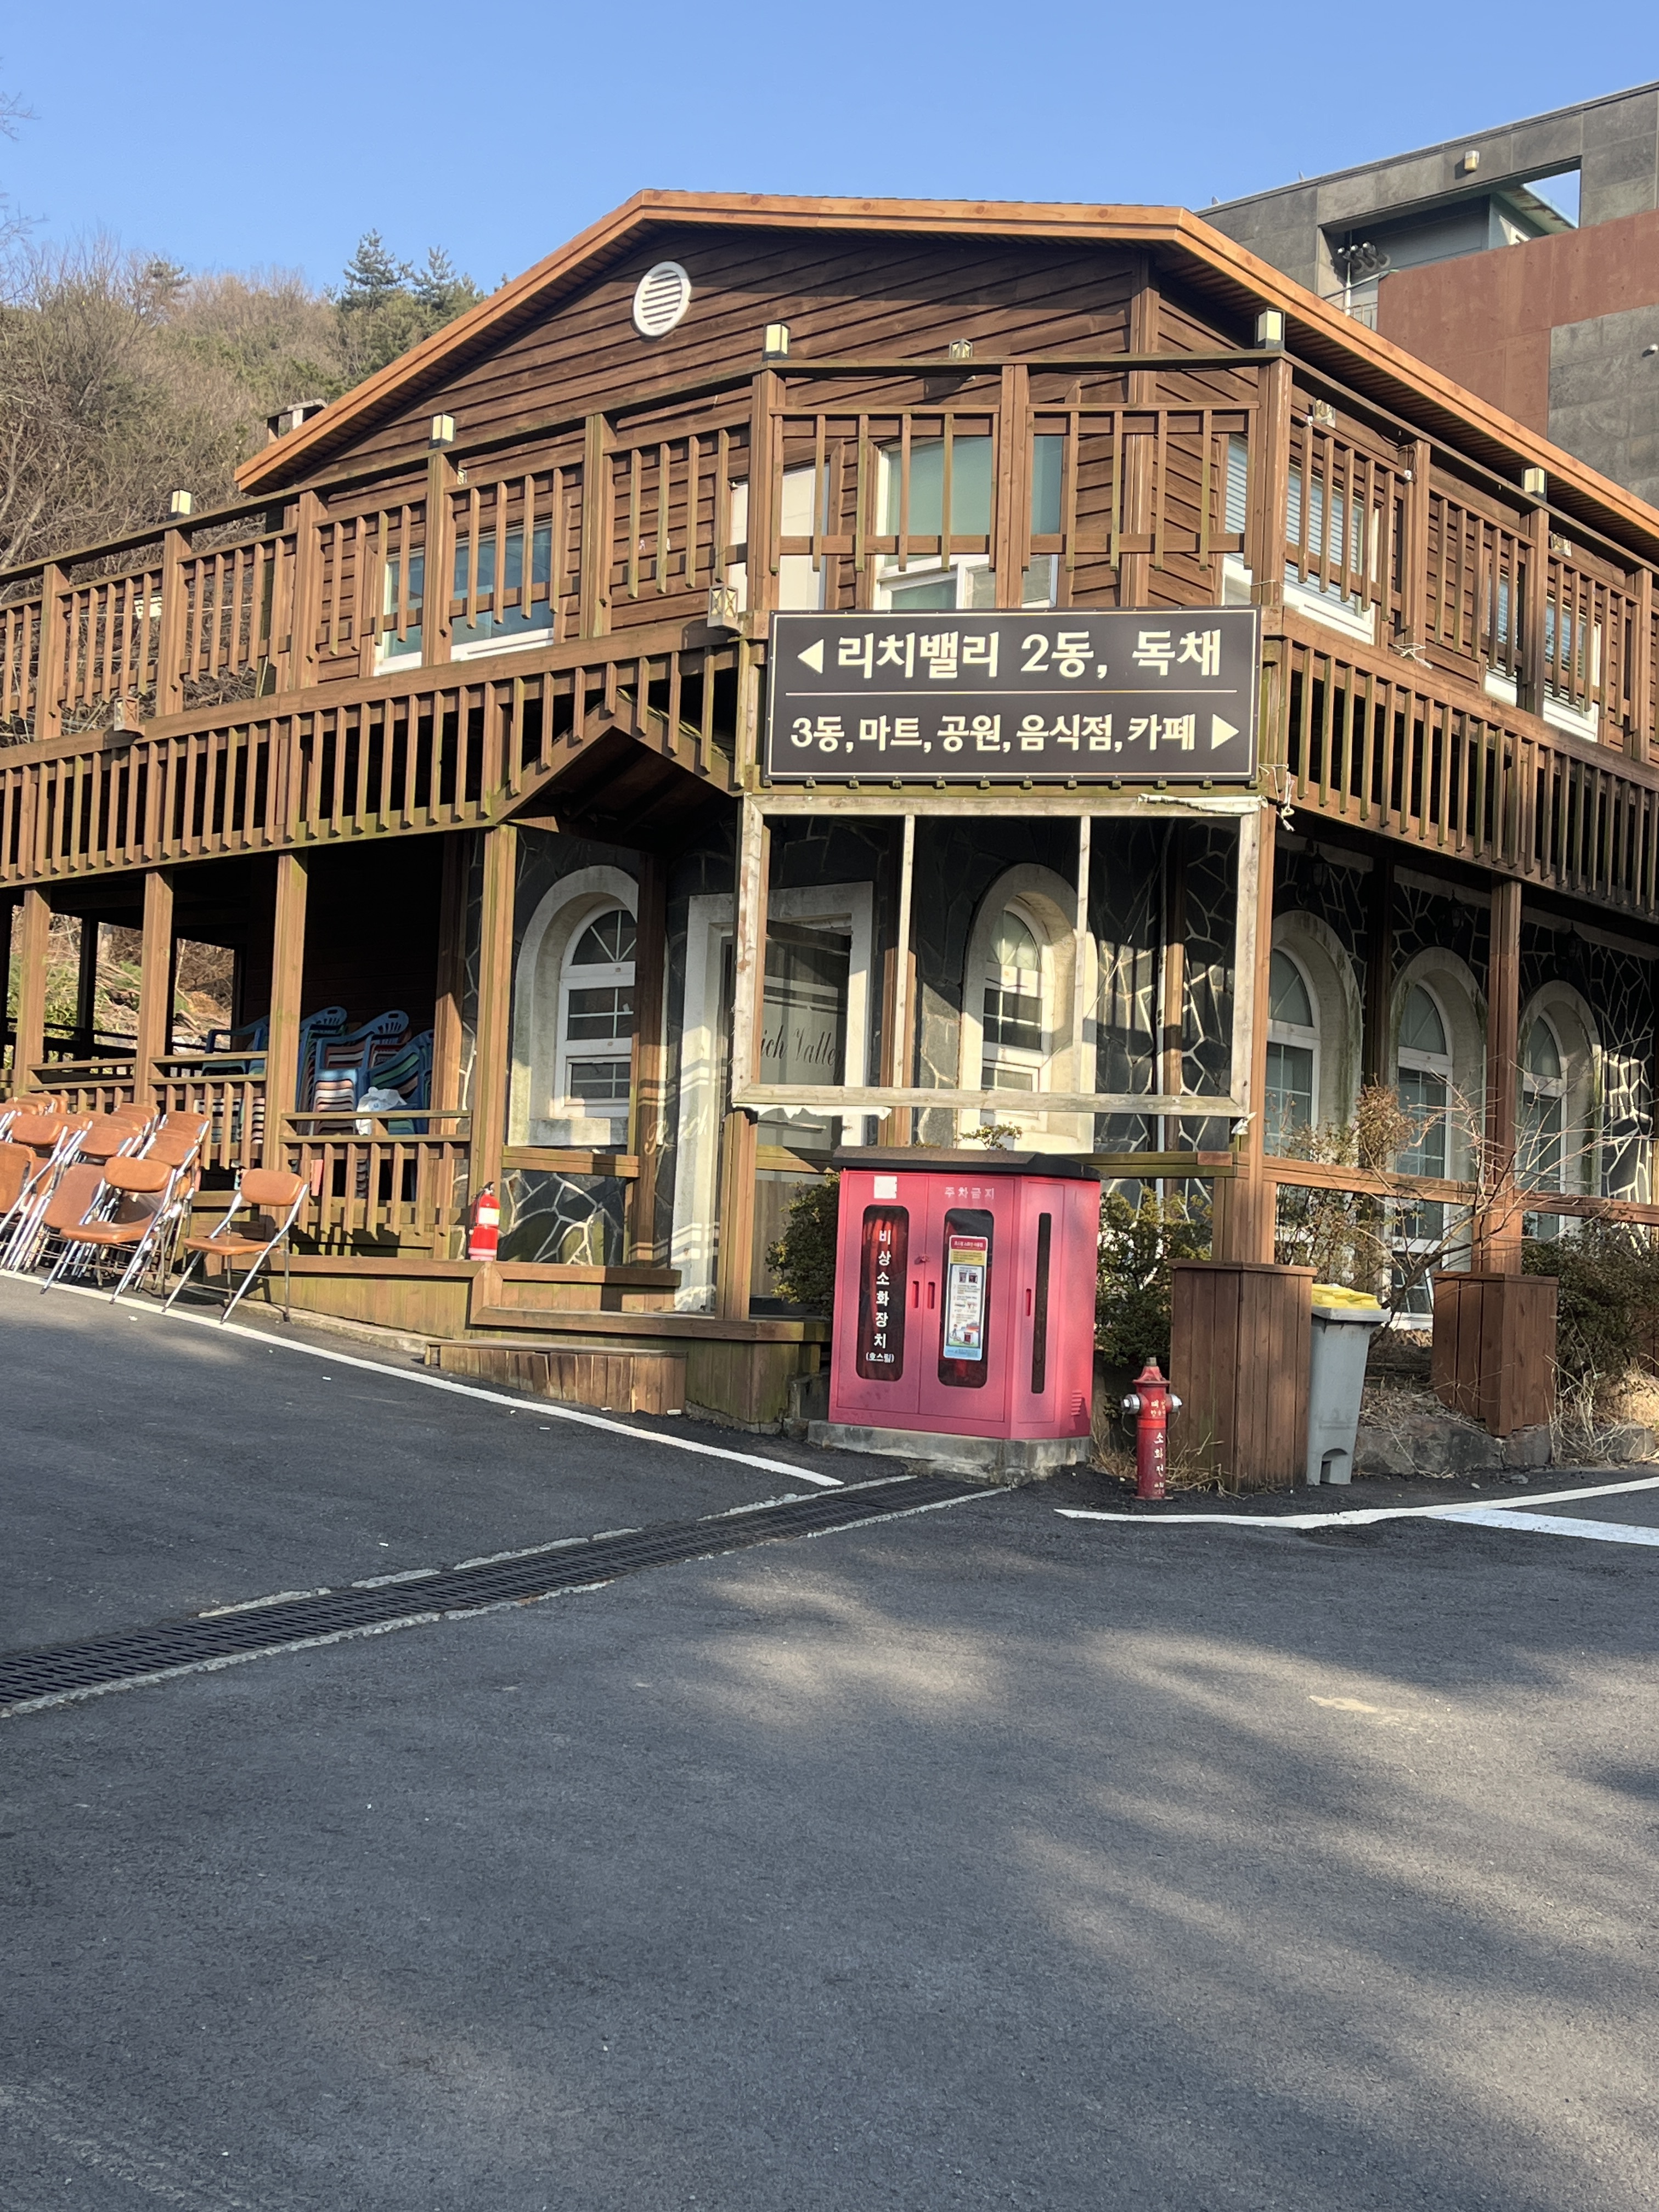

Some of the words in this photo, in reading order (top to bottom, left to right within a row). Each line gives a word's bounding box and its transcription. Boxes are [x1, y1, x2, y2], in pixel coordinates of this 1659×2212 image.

[838, 631, 999, 679] 리치밸리
[1020, 631, 1108, 679] 2동,
[1132, 629, 1221, 676] 독채
[760, 1024, 789, 1059] ich
[945, 1187, 994, 1200] 주차금지
[873, 1229, 891, 1348] 비상소화장치
